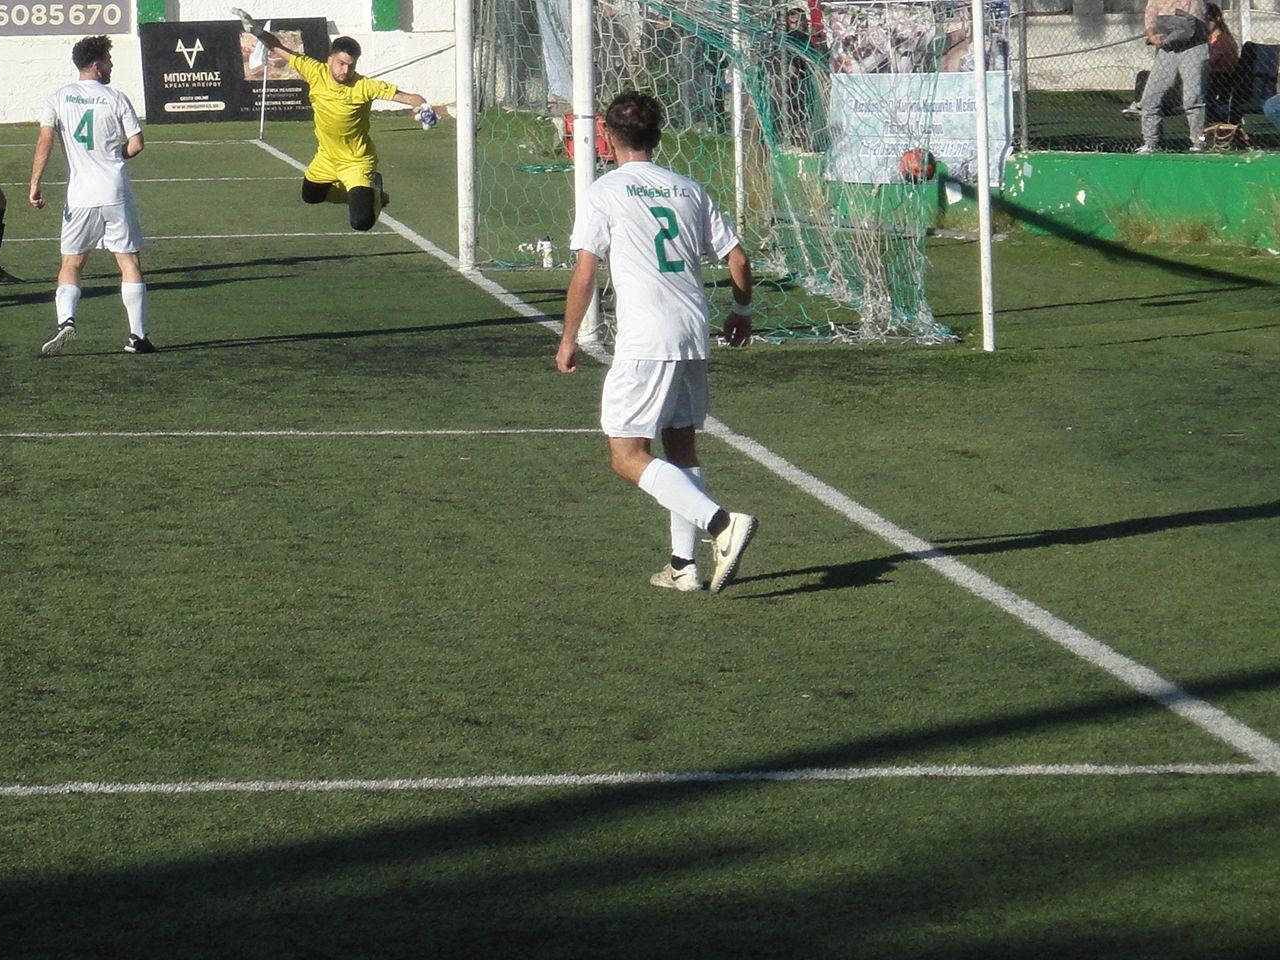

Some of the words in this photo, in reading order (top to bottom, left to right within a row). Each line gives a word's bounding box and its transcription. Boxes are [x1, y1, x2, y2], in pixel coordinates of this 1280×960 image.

[163, 71, 222, 83] ΜΠΟΥΜΠΑΣ
[72, 108, 95, 151] 4
[649, 206, 686, 273] 2
